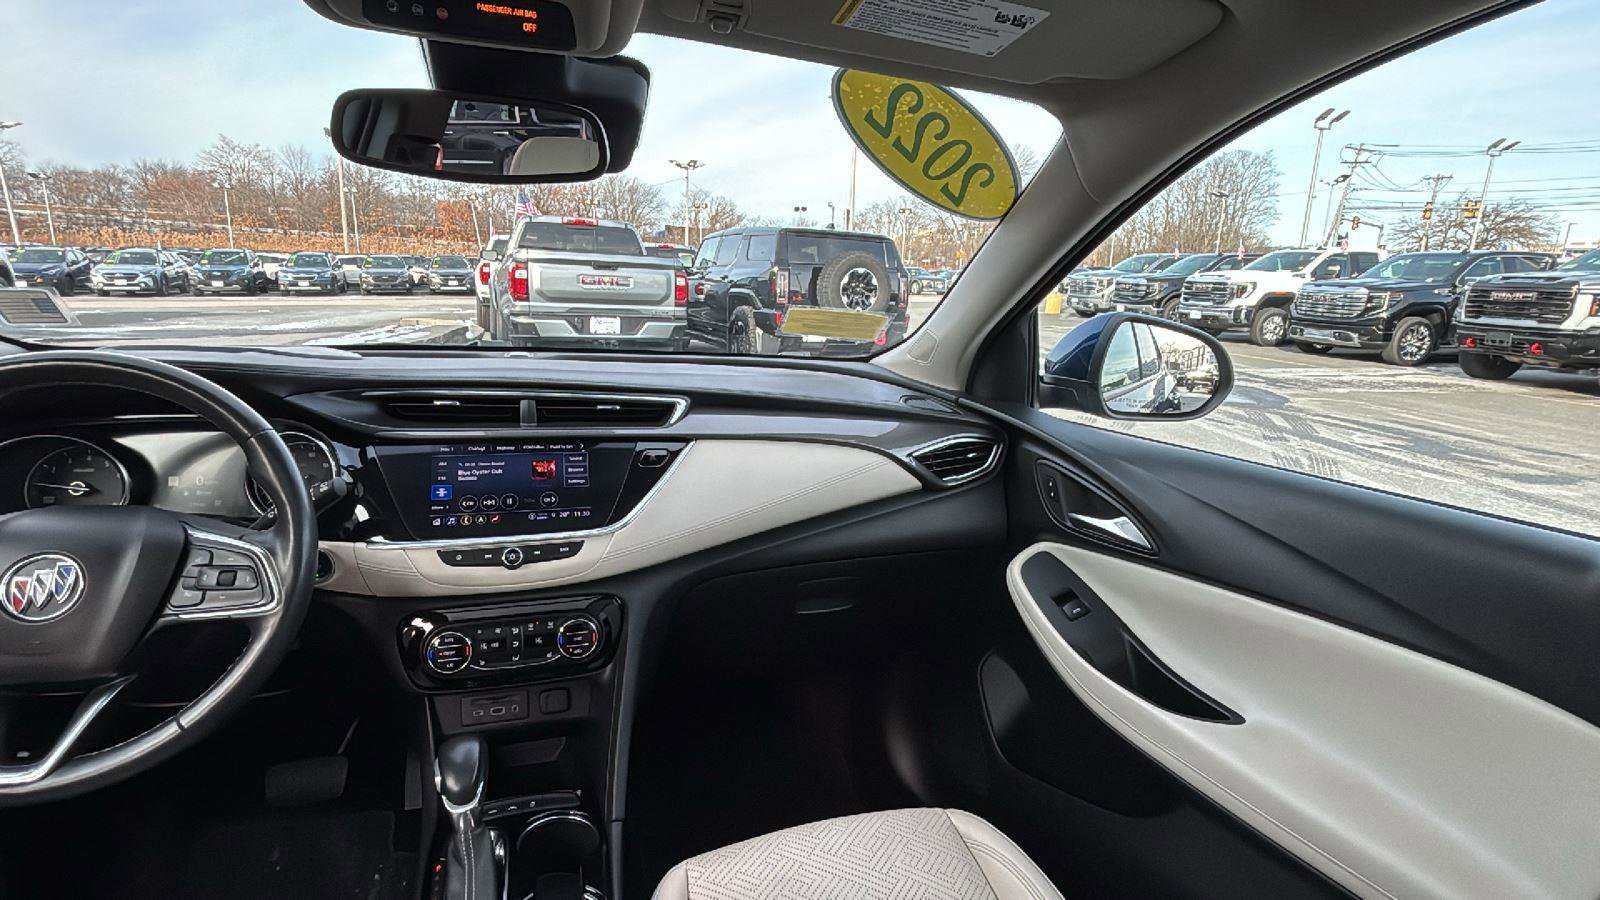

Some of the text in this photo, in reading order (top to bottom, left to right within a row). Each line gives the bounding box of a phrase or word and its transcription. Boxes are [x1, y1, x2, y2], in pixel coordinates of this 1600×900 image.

[476, 2, 538, 19] PASSENGER AIR BAG
[522, 22, 538, 33] OFF
[580, 275, 632, 286] GMC
[1489, 291, 1538, 302] GMC
